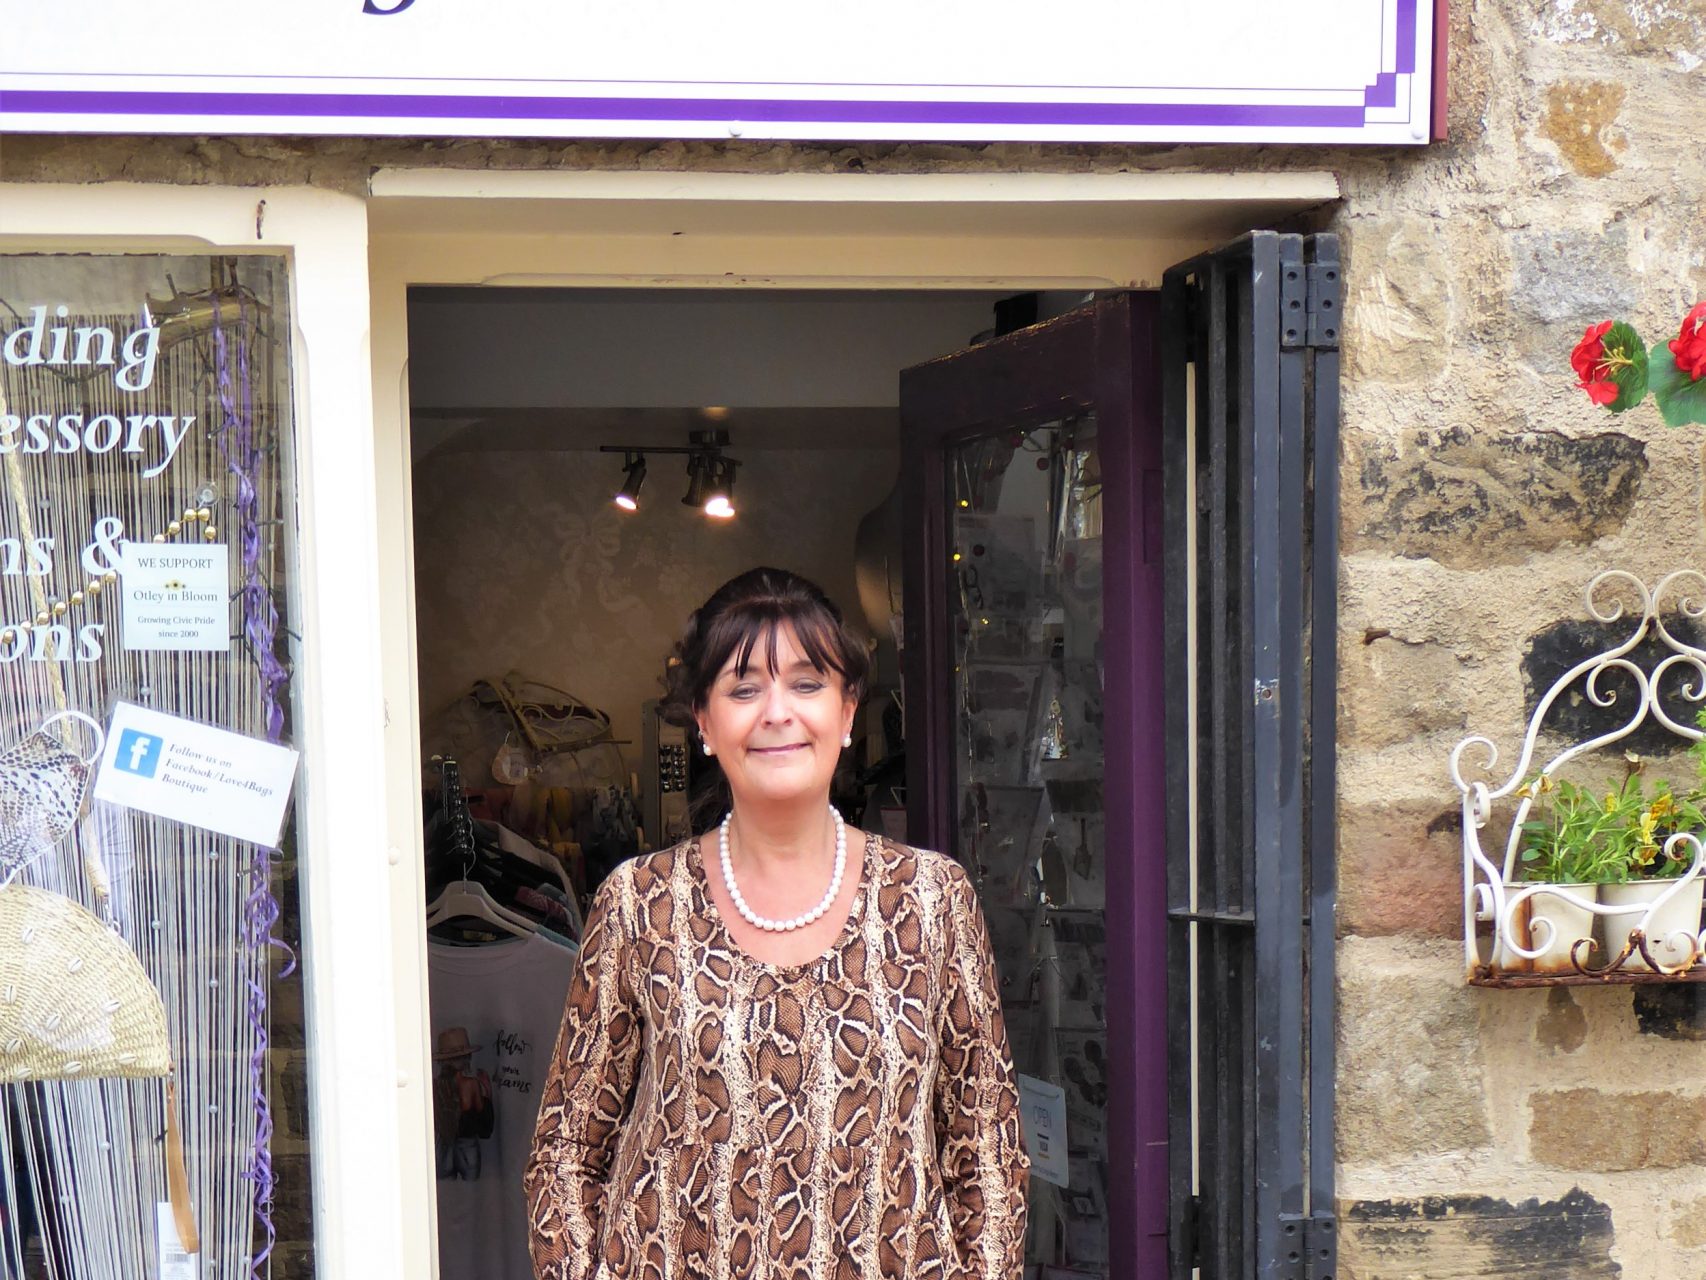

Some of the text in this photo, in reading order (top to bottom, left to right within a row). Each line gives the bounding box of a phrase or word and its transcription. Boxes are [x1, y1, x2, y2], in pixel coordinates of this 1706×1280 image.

[3, 304, 161, 391] ding
[81, 516, 129, 576] &
[138, 558, 213, 569] WE SUPPORT
[133, 590, 218, 603] Otley in Bloom
[137, 616, 216, 625] Growing Civic Pride
[158, 630, 199, 638] since 2000
[169, 743, 232, 769] Follow us on
[162, 773, 208, 794] Boutique
